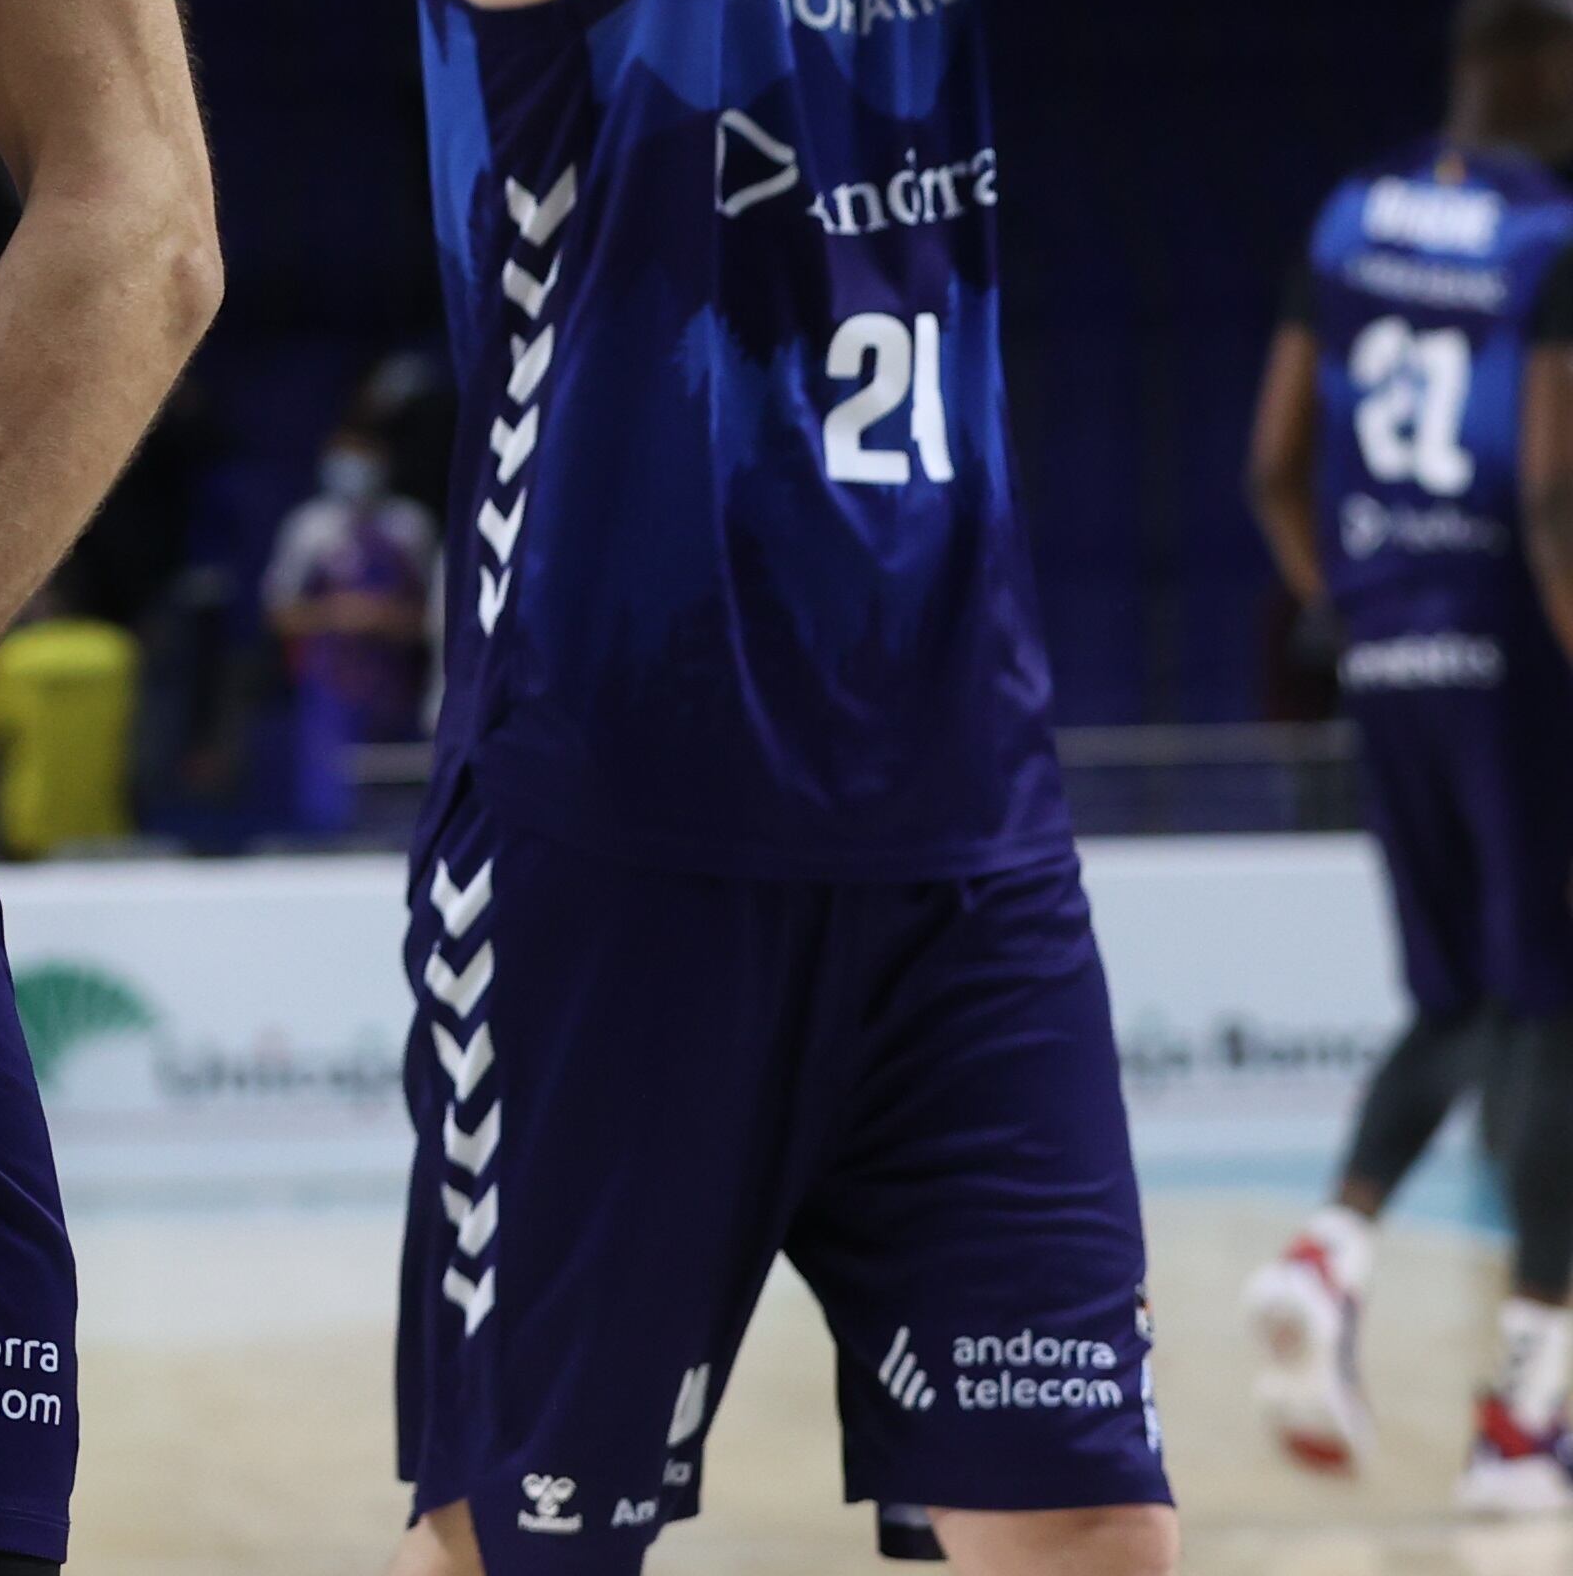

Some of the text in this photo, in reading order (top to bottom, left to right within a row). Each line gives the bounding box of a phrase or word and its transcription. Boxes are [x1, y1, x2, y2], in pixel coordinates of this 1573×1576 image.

[822, 312, 954, 484] 21
[953, 1328, 1117, 1370] andorra
[956, 1369, 1123, 1411] telecom
